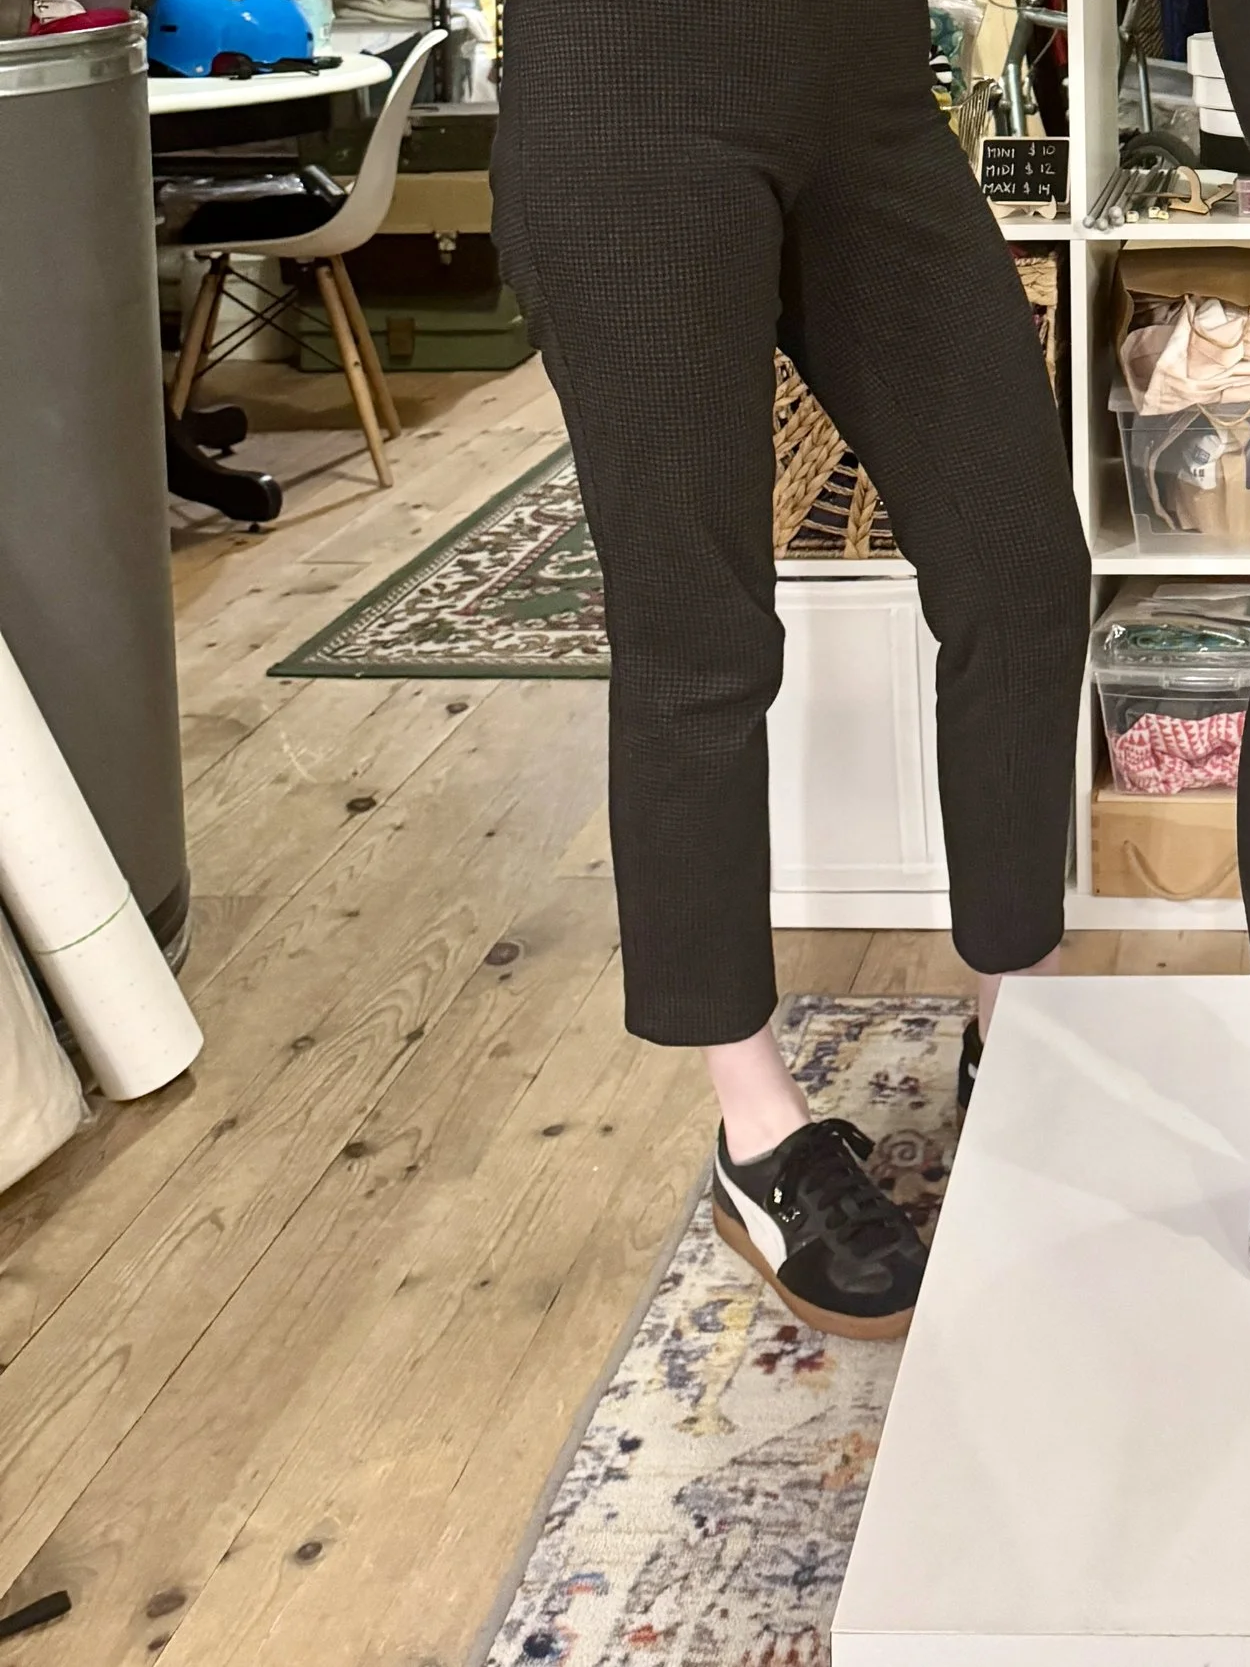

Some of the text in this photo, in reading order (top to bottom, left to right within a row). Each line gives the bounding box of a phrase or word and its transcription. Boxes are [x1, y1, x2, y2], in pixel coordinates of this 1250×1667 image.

[987, 146, 1015, 158] MINI
[1042, 145, 1056, 156] 10
[986, 163, 1014, 177] MIDI
[1040, 163, 1056, 174] 12
[982, 182, 1016, 194] MAXI
[1038, 184, 1051, 195] 14
